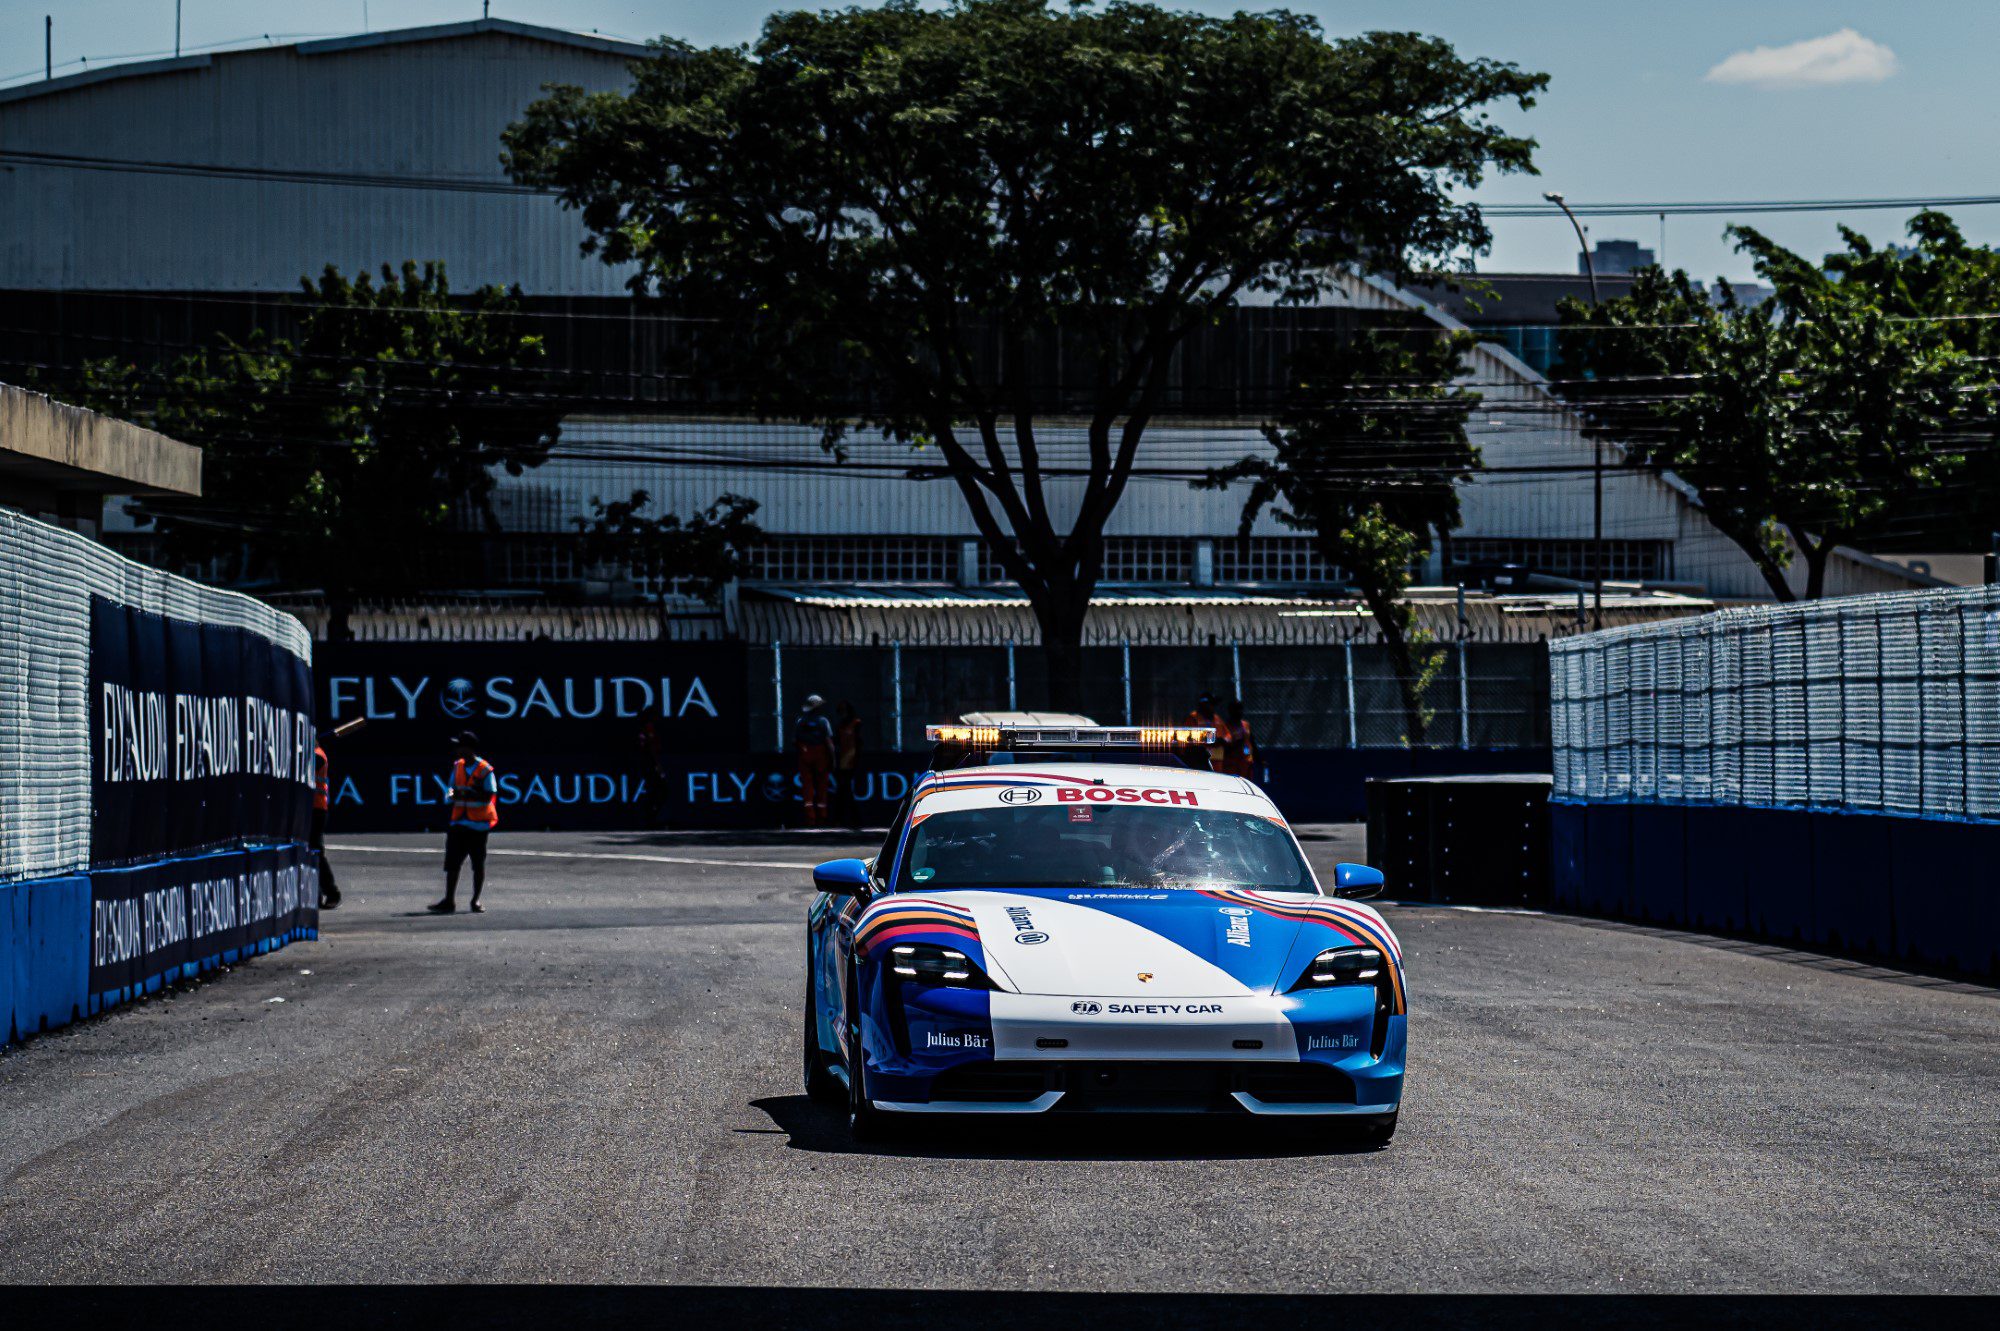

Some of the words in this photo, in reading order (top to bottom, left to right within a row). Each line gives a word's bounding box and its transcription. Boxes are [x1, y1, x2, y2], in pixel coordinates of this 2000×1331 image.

[329, 676, 429, 719] FLY
[485, 675, 719, 719] SAUDIA
[687, 772, 755, 803] FLY
[1056, 787, 1199, 807] BOSCH
[1226, 915, 1251, 947] Allianz
[1108, 1003, 1181, 1014] SAFETY
[1185, 1004, 1223, 1014] CAR
[926, 1031, 961, 1048] Julius
[963, 1033, 989, 1048] Bär
[1307, 1035, 1340, 1052] Julius
[1342, 1034, 1359, 1048] Bär
